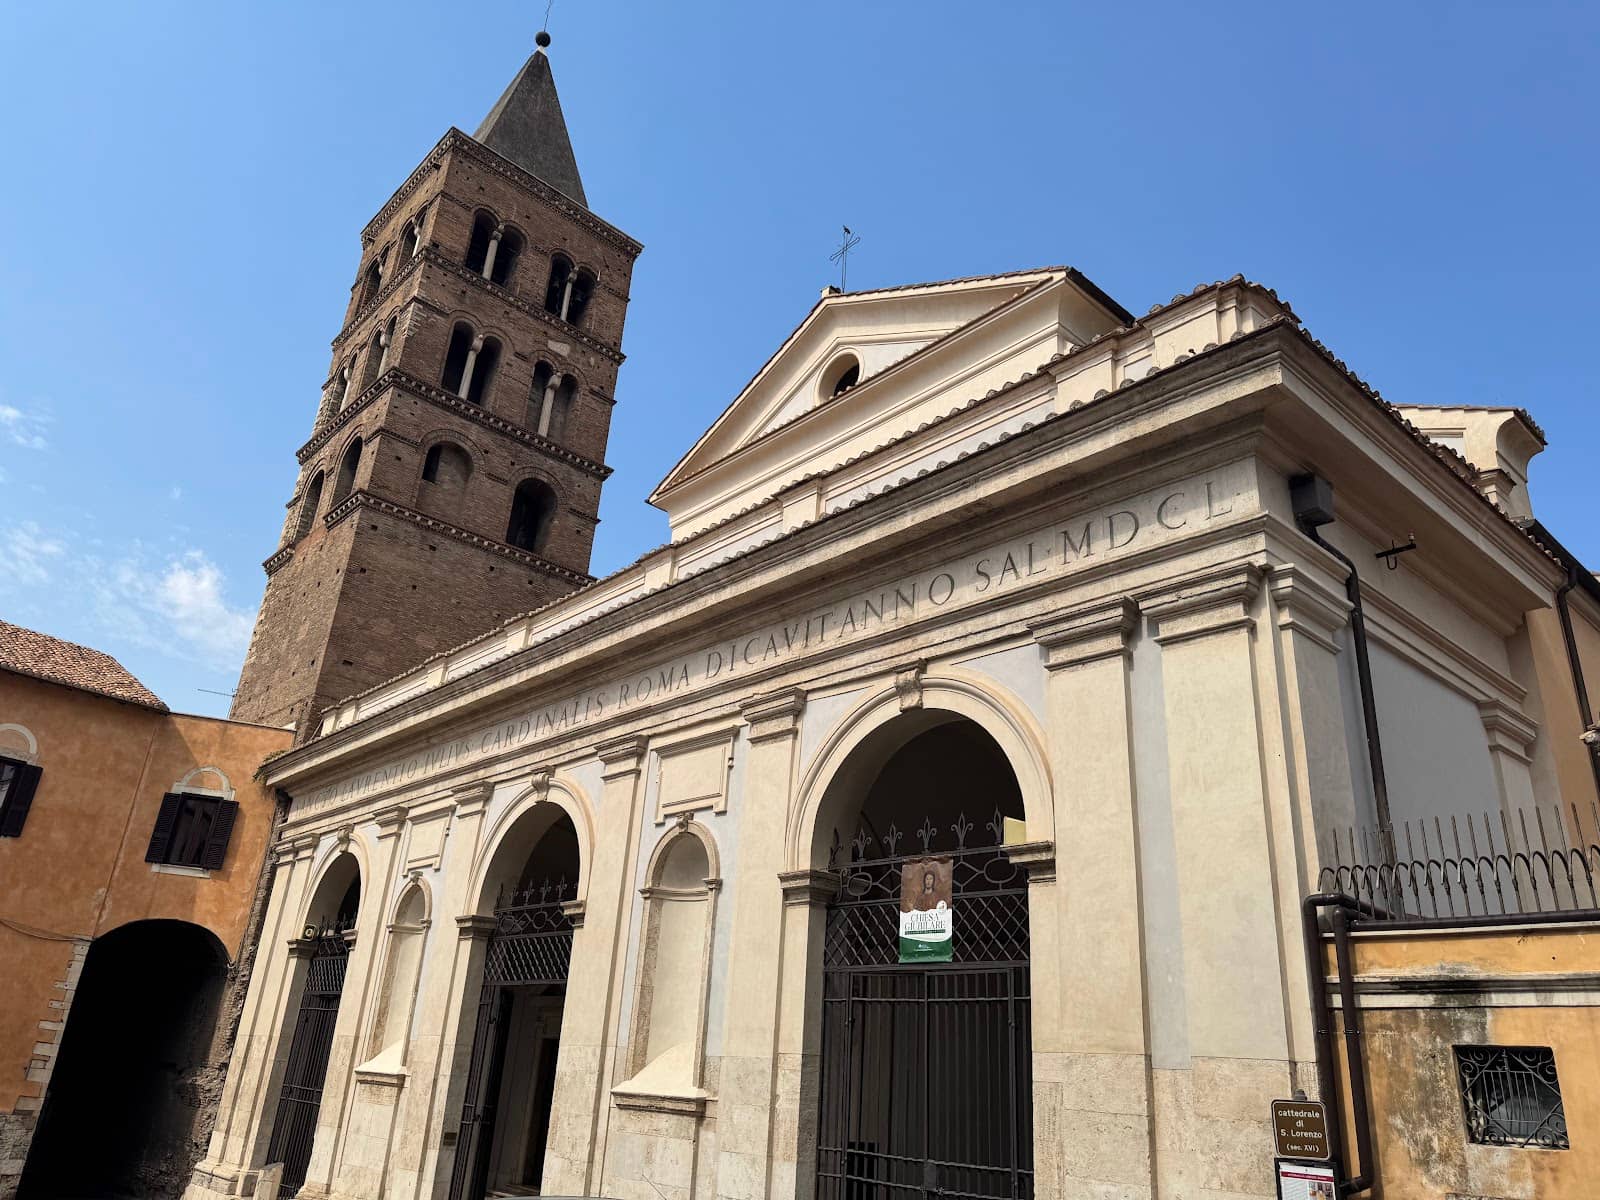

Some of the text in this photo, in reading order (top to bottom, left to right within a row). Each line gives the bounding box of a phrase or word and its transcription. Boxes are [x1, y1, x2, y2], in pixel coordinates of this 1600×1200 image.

[480, 692, 606, 754] CARDINALIS
[618, 663, 690, 710] ROMA
[705, 611, 833, 680] DICAVIT
[837, 573, 955, 638] ANNO
[911, 912, 939, 922] CHIESA
[1278, 1109, 1320, 1118] cattedrale
[1295, 1119, 1304, 1127] di
[1280, 1128, 1323, 1139] S. Lorenzo
